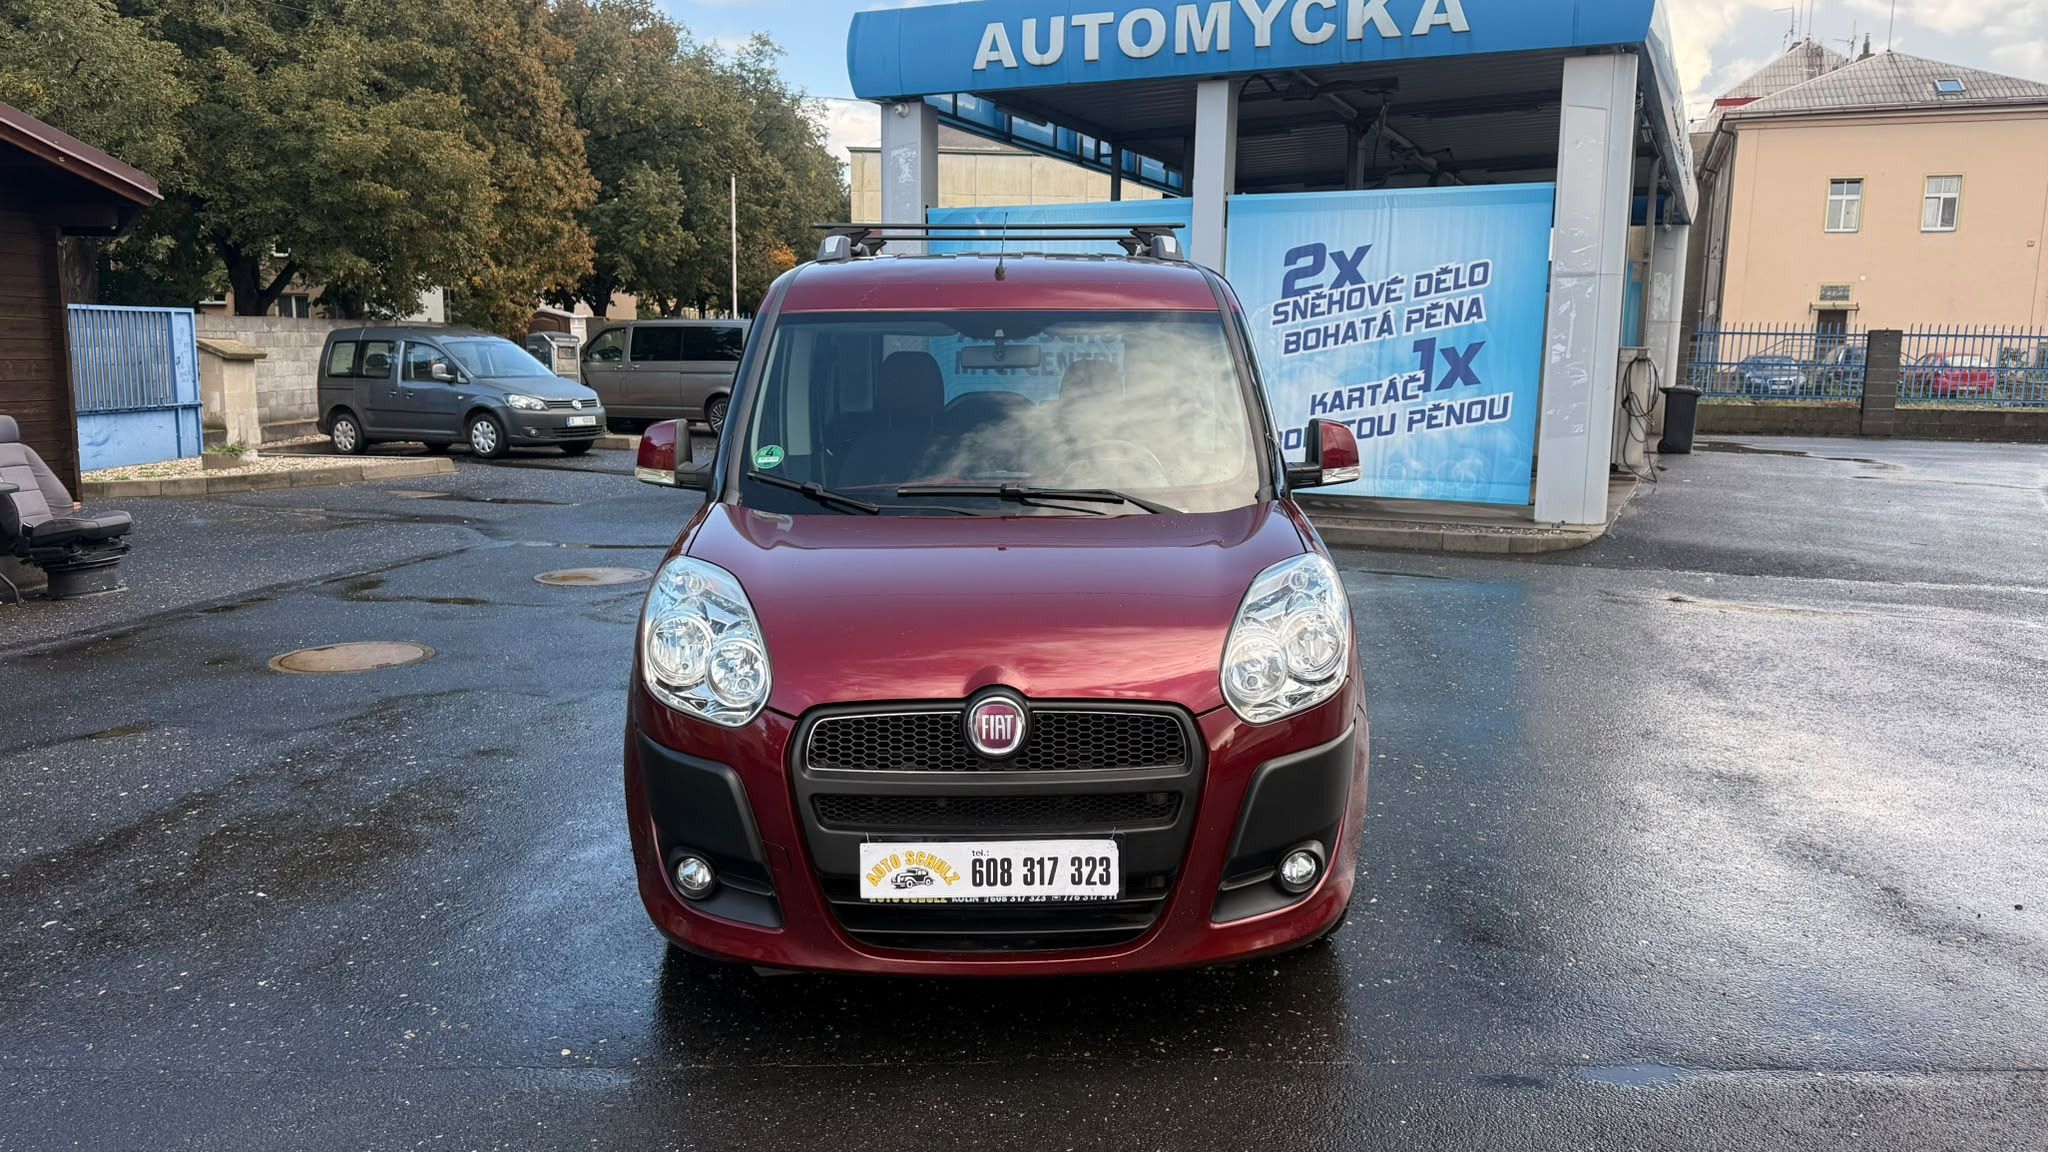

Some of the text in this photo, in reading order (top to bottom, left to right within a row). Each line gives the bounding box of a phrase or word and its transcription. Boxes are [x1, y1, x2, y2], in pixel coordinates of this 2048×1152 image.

[1272, 261, 1490, 326] SNĚHOVÉ DĚLO
[1283, 296, 1484, 355] BOHATÁ PĚNA
[1310, 372, 1422, 416] KARTÁČ
[1407, 395, 1511, 432] PĚNOU
[765, 446, 774, 457] 4
[981, 714, 1014, 740] FIAT
[866, 850, 960, 887] AUTO SCHULZ
[971, 856, 1111, 887] 608 317 323
